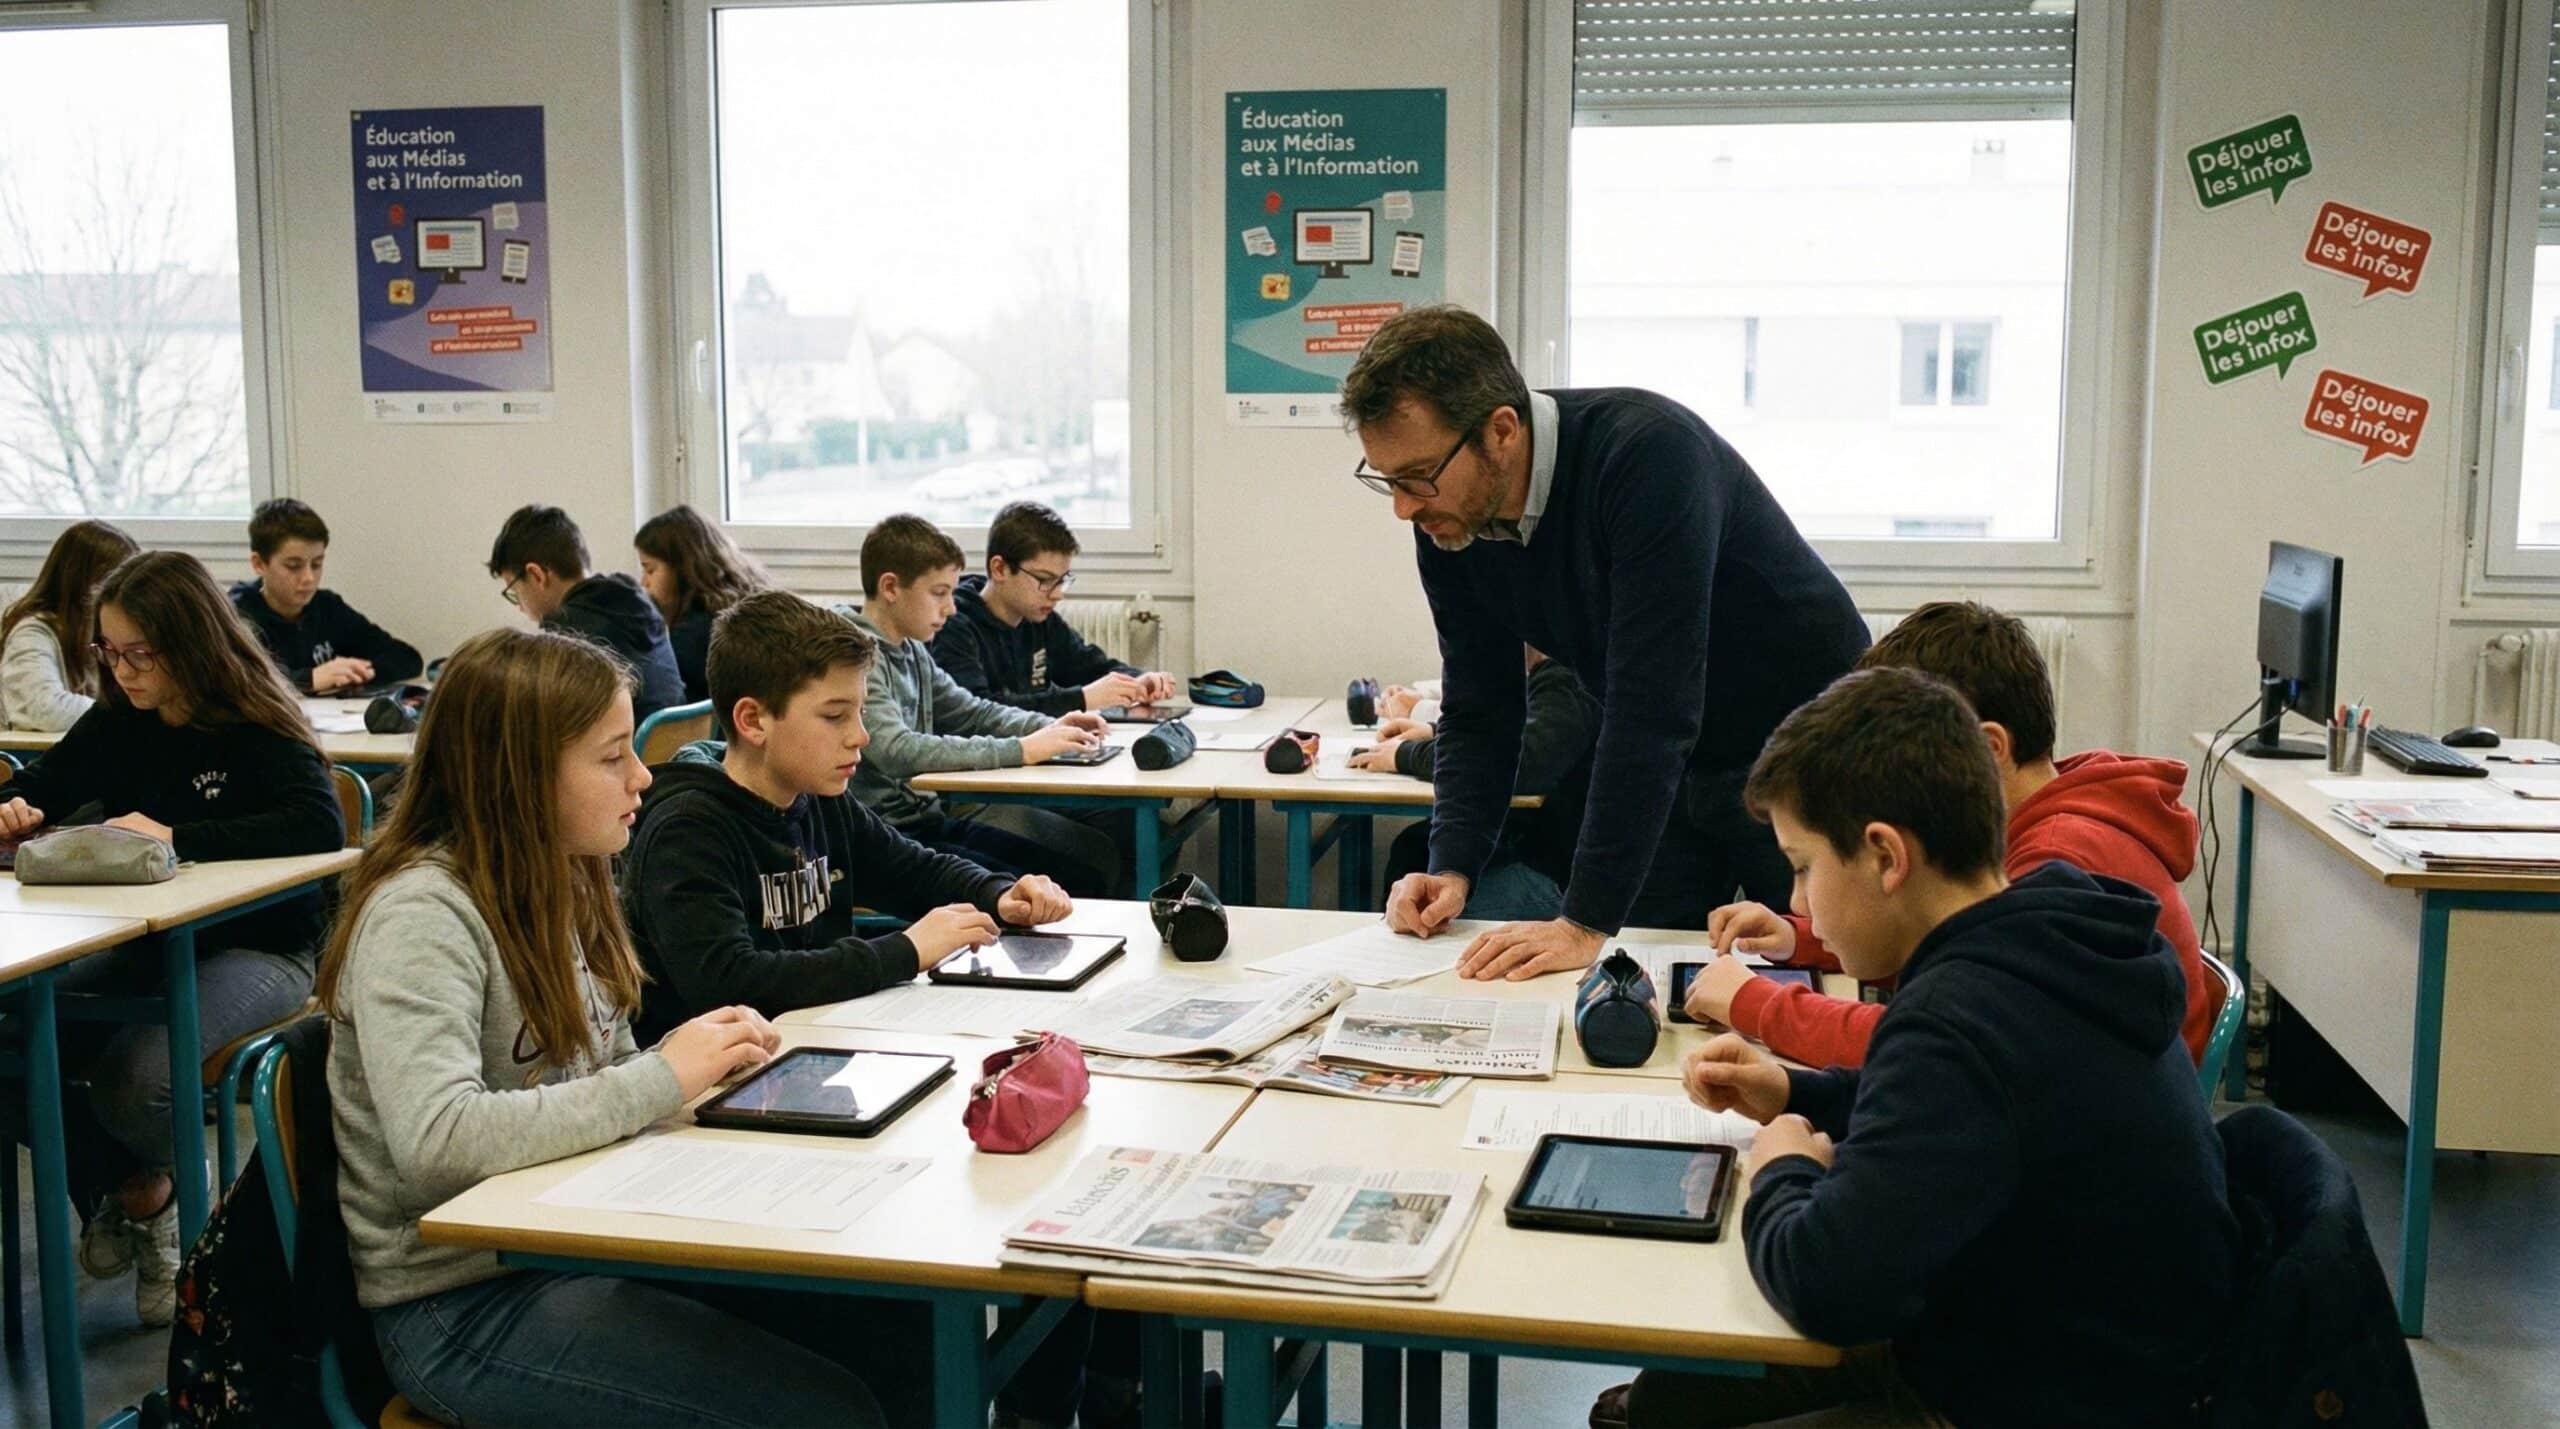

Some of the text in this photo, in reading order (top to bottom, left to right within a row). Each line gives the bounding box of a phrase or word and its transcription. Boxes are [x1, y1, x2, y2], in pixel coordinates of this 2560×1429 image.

[366, 124, 454, 146] Éducation
[1241, 106, 1343, 129] Éducation
[366, 149, 466, 168] aux Médias
[1241, 133, 1355, 153] aux Médias
[1241, 156, 1419, 176] et à l'Information
[2197, 127, 2294, 175] Déjouer
[367, 171, 523, 191] et à l'Information
[2203, 150, 2303, 198] les infox
[2324, 211, 2421, 258] Déjouer
[2313, 234, 2413, 283] les infox
[2203, 304, 2298, 351] Déjouer
[2209, 327, 2309, 374] les infox
[2321, 378, 2418, 424] Déjouer
[2313, 401, 2410, 450] les infox
